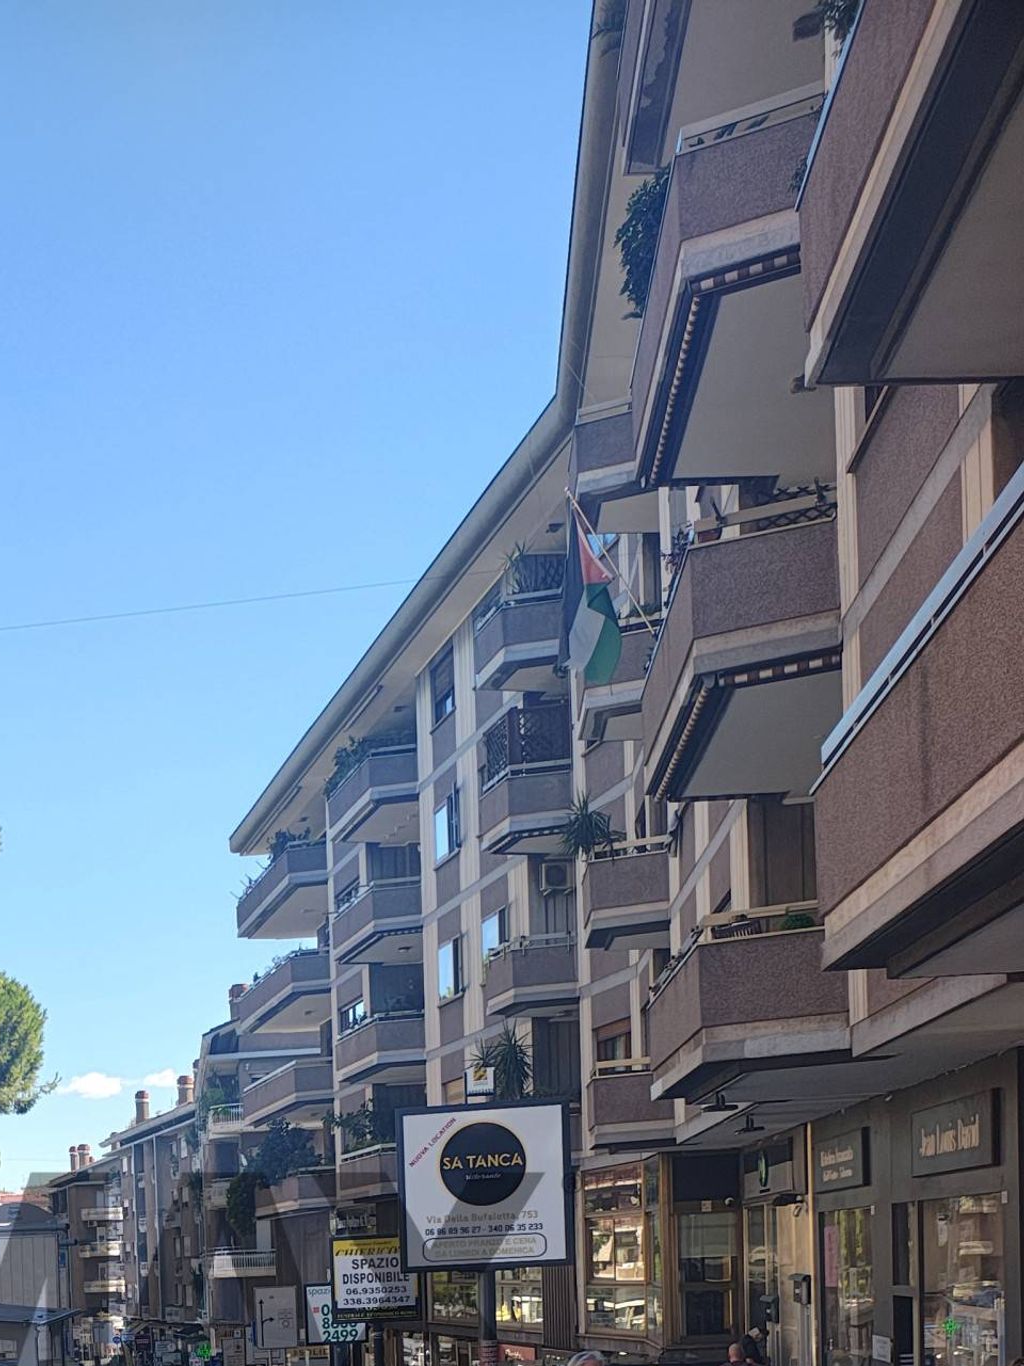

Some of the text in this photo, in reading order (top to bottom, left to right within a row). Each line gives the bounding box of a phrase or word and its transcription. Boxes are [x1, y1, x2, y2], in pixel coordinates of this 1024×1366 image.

[919, 1113, 980, 1158] Jean Louis David
[409, 1117, 457, 1168] NUOVA LOCATION
[442, 1152, 523, 1170] SA TANCA
[427, 1215, 441, 1224] Via
[521, 1210, 538, 1219] 753
[425, 1228, 435, 1236] 06
[517, 1223, 526, 1231] 35
[528, 1223, 543, 1231] 233
[351, 1257, 399, 1270] SPAZIO
[342, 1271, 410, 1284] DISPONIBILE
[322, 1329, 358, 1342] 2499
